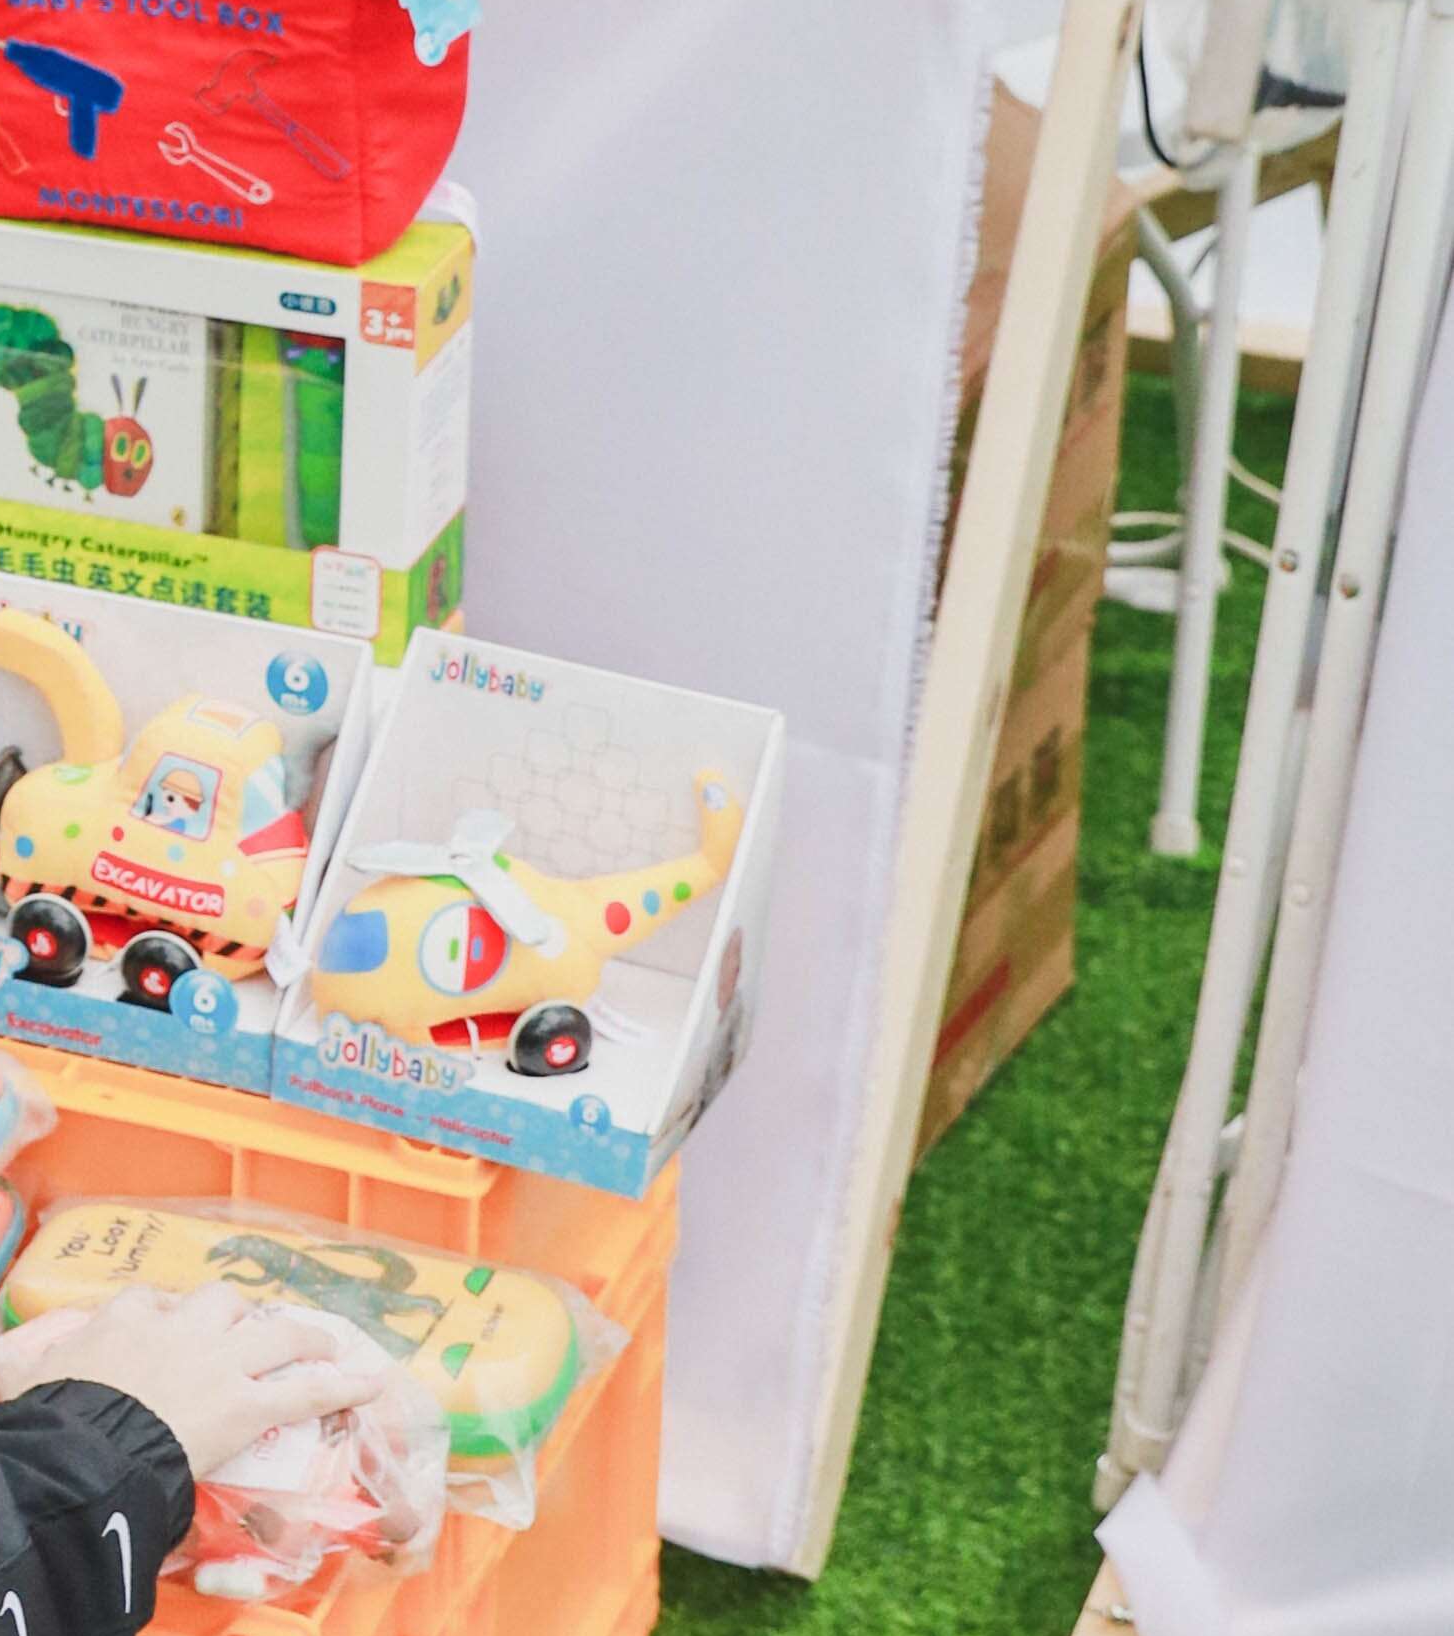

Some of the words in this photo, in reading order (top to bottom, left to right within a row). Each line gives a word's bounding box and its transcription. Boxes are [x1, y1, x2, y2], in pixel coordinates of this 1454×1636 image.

[218, 3, 285, 35] BOX
[39, 187, 244, 229] MONTESSORI
[284, 660, 311, 693] 6
[430, 651, 545, 702] jollybaby
[93, 856, 225, 917] EXCAVATOR
[192, 977, 219, 1015] 6
[6, 1011, 104, 1048] Excavator
[325, 1031, 457, 1089] jollybaby
[288, 1075, 355, 1105] Pullback
[359, 1093, 405, 1119] Plane
[429, 1115, 516, 1147] Helicopter
